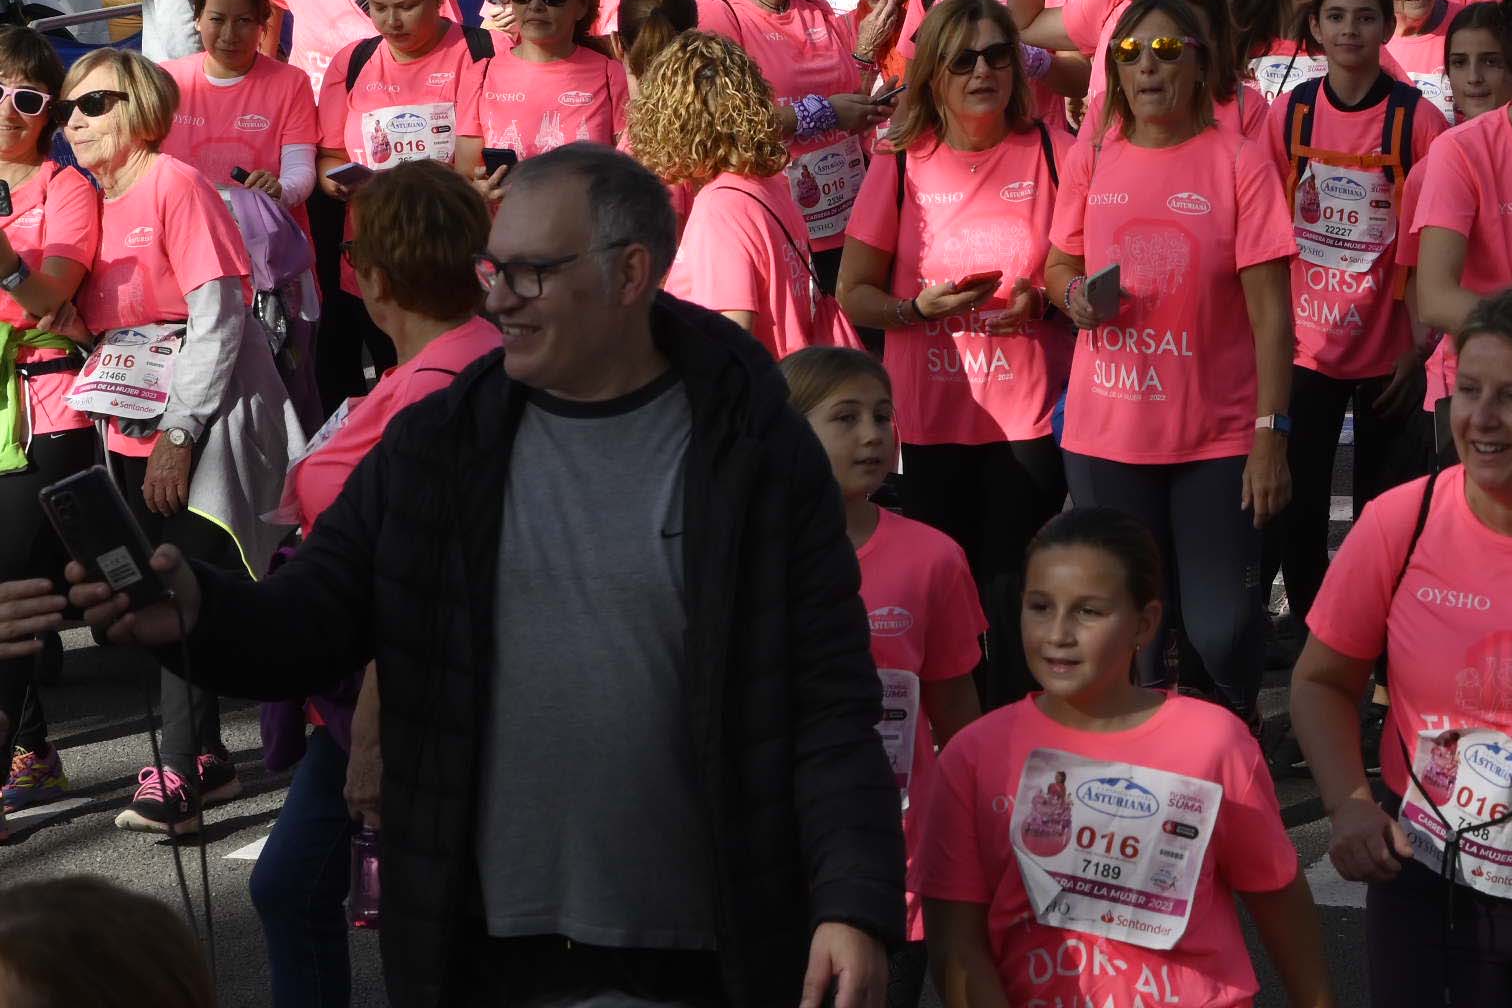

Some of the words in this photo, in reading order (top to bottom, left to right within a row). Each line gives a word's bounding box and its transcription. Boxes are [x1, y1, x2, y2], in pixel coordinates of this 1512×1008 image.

[394, 139, 425, 154] 016
[822, 176, 846, 196] 016
[1323, 182, 1364, 198] ASTURIANA
[914, 192, 964, 206] OYSHO
[1088, 192, 1129, 206] OYSHO
[1170, 200, 1208, 212] ASTURIANA
[1322, 205, 1360, 225] 016
[1324, 224, 1353, 237] 22227
[1344, 241, 1366, 250] MUJER
[102, 353, 136, 369] 016
[927, 347, 1010, 374] SUMA
[99, 370, 127, 382] 21466
[1093, 359, 1163, 392] SUMA
[119, 400, 157, 415] Santander
[1416, 586, 1491, 611] OYSHO
[1082, 786, 1154, 814] ASTURIANA
[1167, 798, 1203, 813] SUMA
[1456, 785, 1510, 822] 016
[1075, 824, 1142, 861] 016
[1417, 812, 1448, 842] CARRER
[1464, 842, 1478, 854] LA
[1081, 858, 1122, 881] 7189
[1075, 880, 1091, 891] DE
[1093, 885, 1107, 897] LA
[1109, 888, 1147, 904] MUJER
[1149, 898, 1174, 911] 2023
[1116, 913, 1173, 938] Santander
